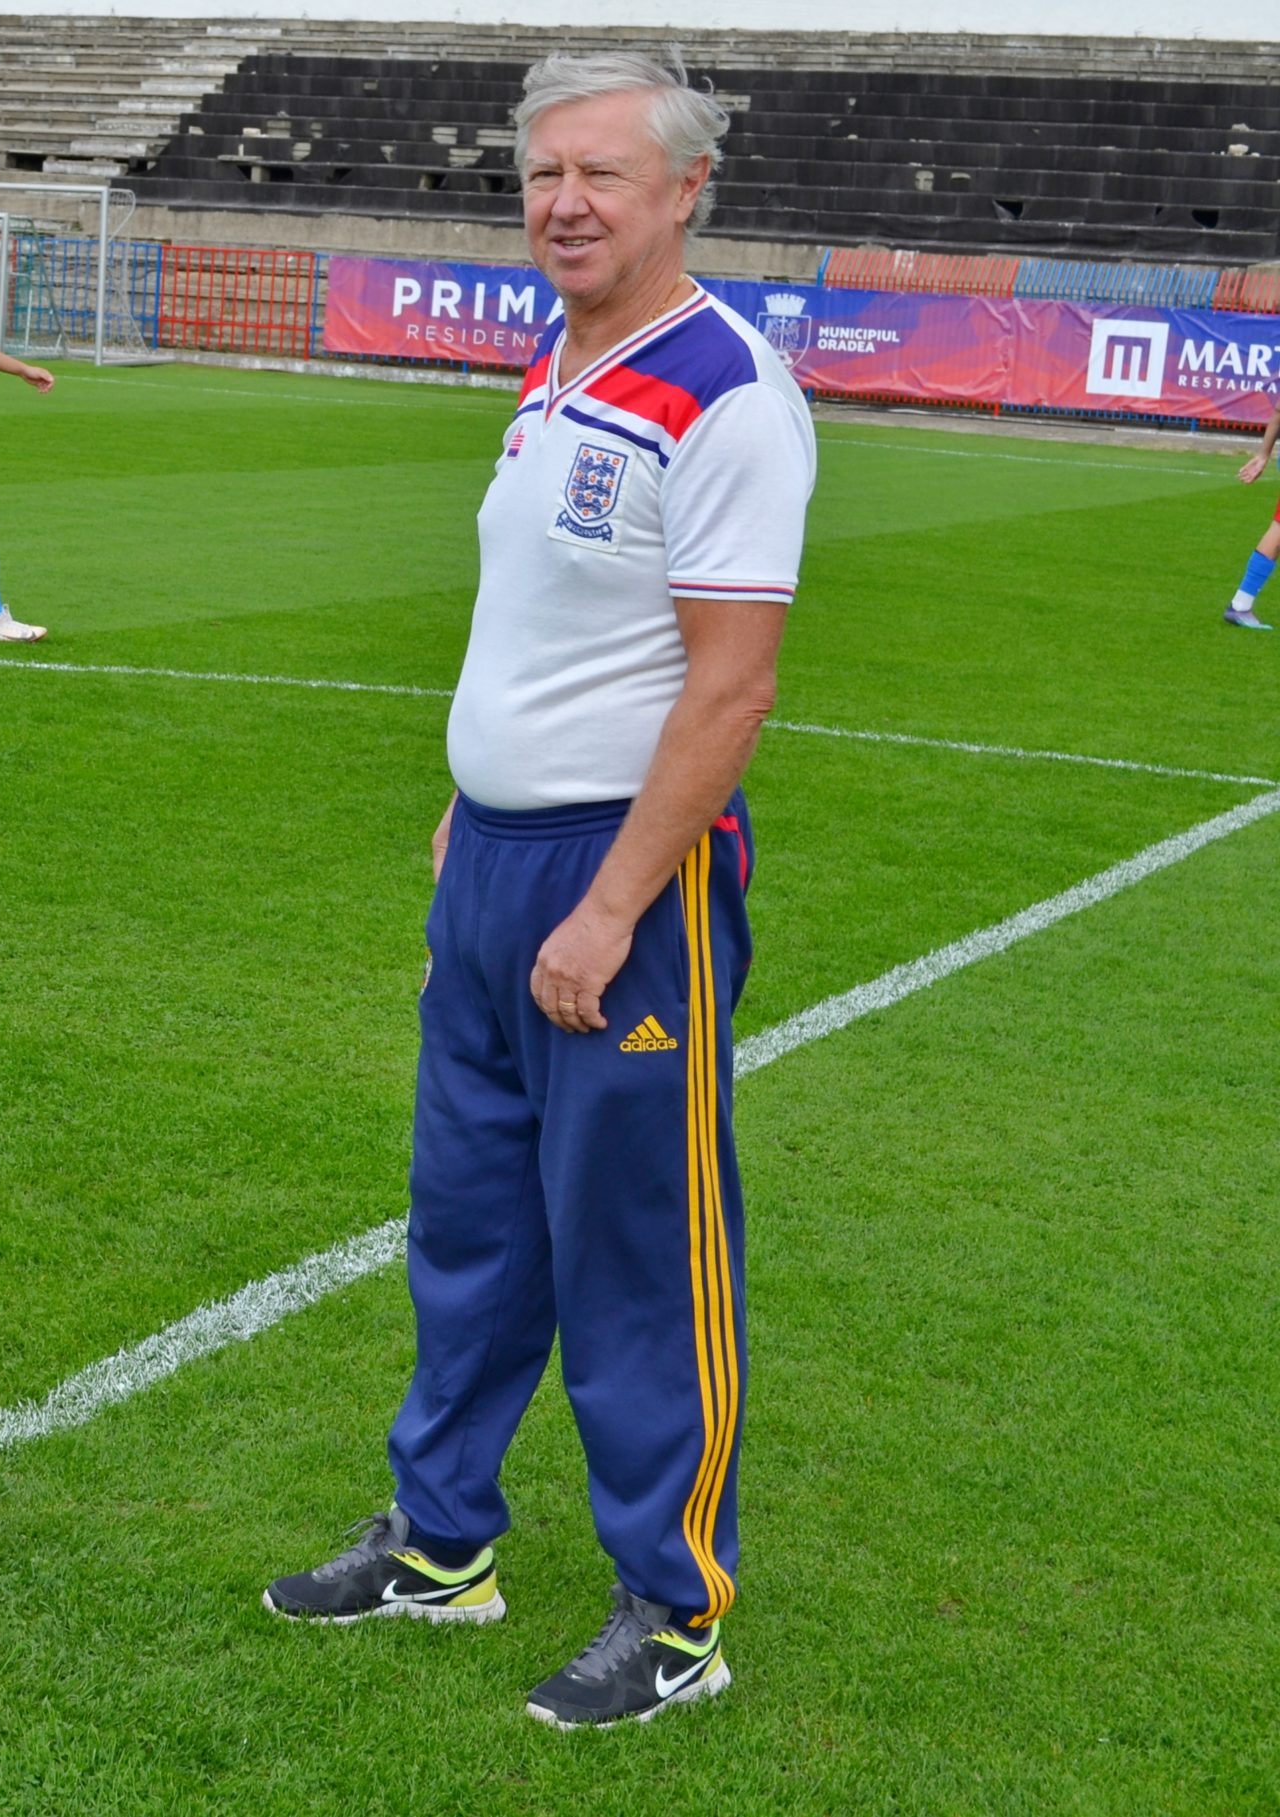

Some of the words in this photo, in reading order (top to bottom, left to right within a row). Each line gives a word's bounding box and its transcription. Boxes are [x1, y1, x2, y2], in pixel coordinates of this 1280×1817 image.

[818, 325, 900, 343] MUNICIPIUL
[817, 338, 876, 353] ORADEA
[1178, 374, 1278, 394] RESTAURA
[619, 1037, 678, 1052] adidas
